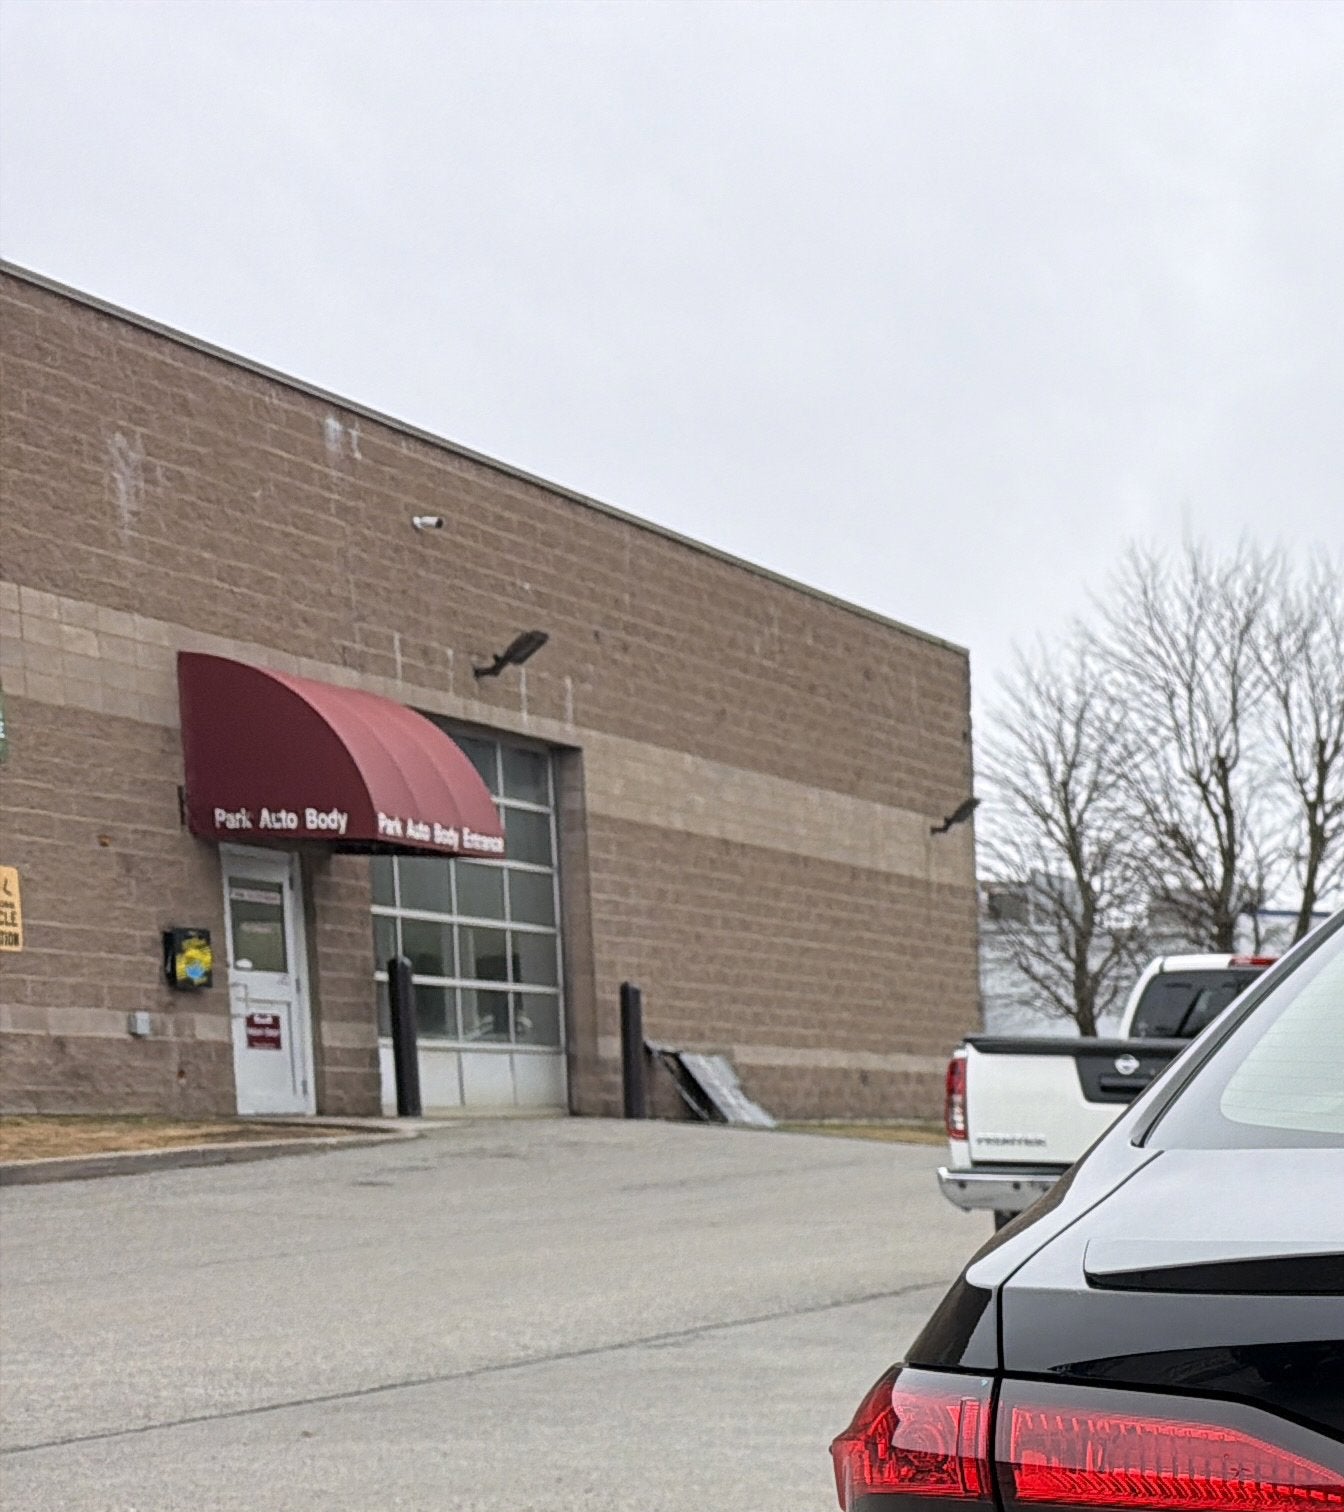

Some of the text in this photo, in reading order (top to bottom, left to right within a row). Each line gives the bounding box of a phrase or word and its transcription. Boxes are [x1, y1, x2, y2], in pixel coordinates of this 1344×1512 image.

[214, 807, 348, 834] Park Auto Body
[377, 812, 403, 834] Park
[406, 817, 431, 842] Auto
[433, 822, 460, 852] Body
